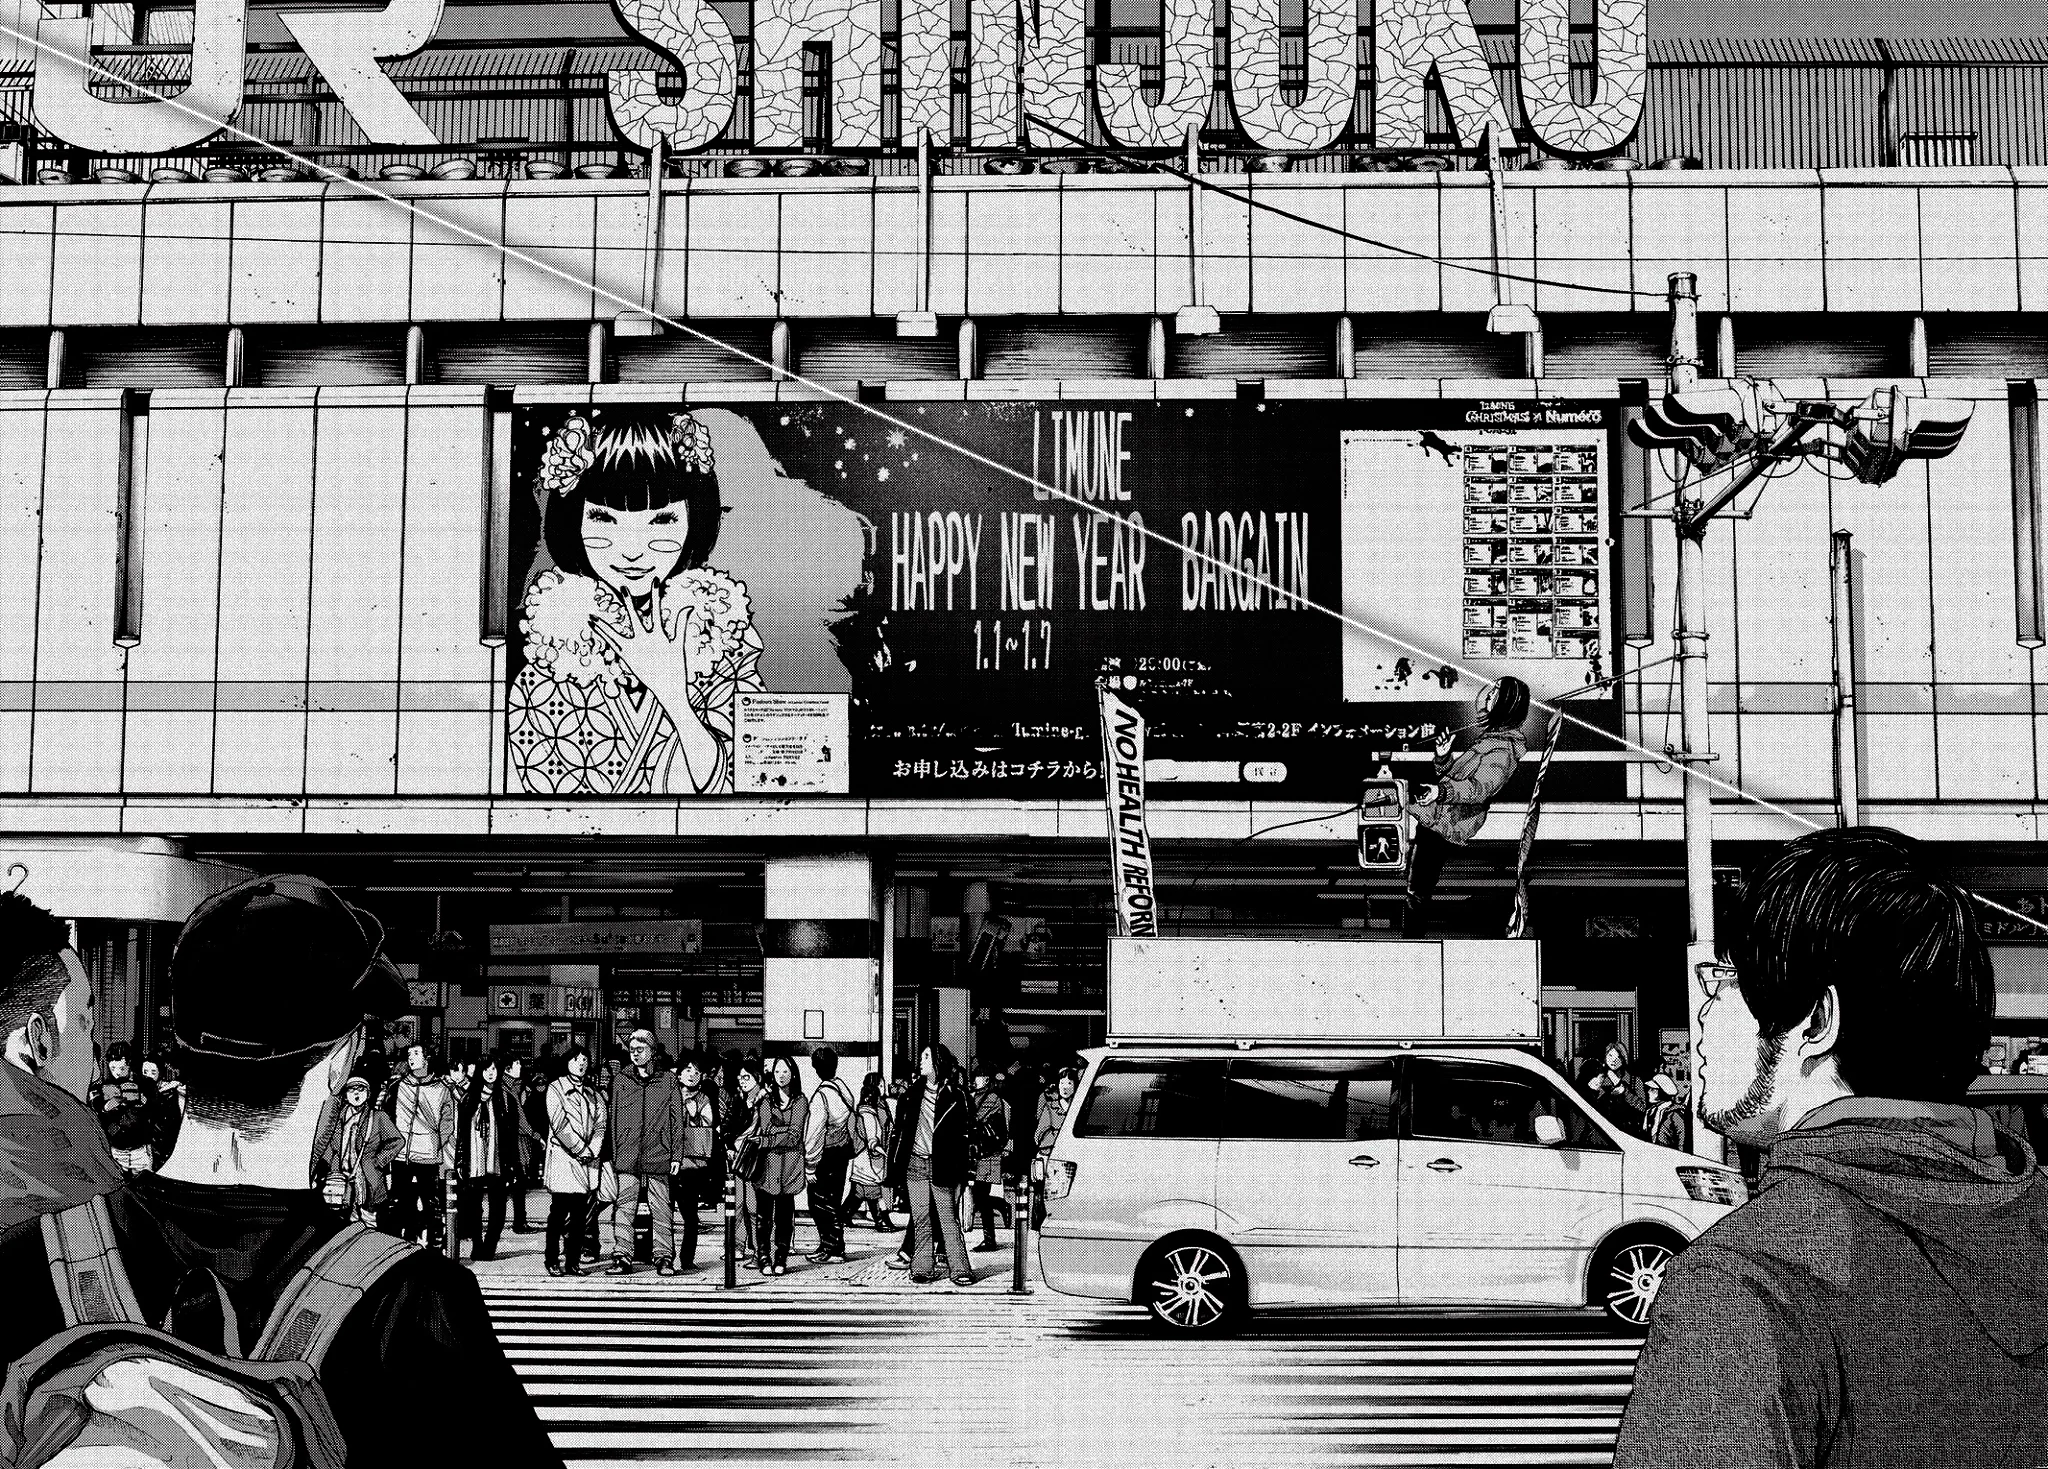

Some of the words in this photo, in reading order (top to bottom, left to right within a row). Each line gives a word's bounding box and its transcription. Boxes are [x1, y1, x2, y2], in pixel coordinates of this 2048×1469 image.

[1033, 410, 1132, 501] LIMUNE
[890, 511, 982, 611] HAPPY
[1001, 511, 1054, 611] NEW
[1074, 511, 1146, 611] YEAR
[1182, 511, 1309, 611] BARGAIN
[1117, 762, 1146, 860] HEALTH
